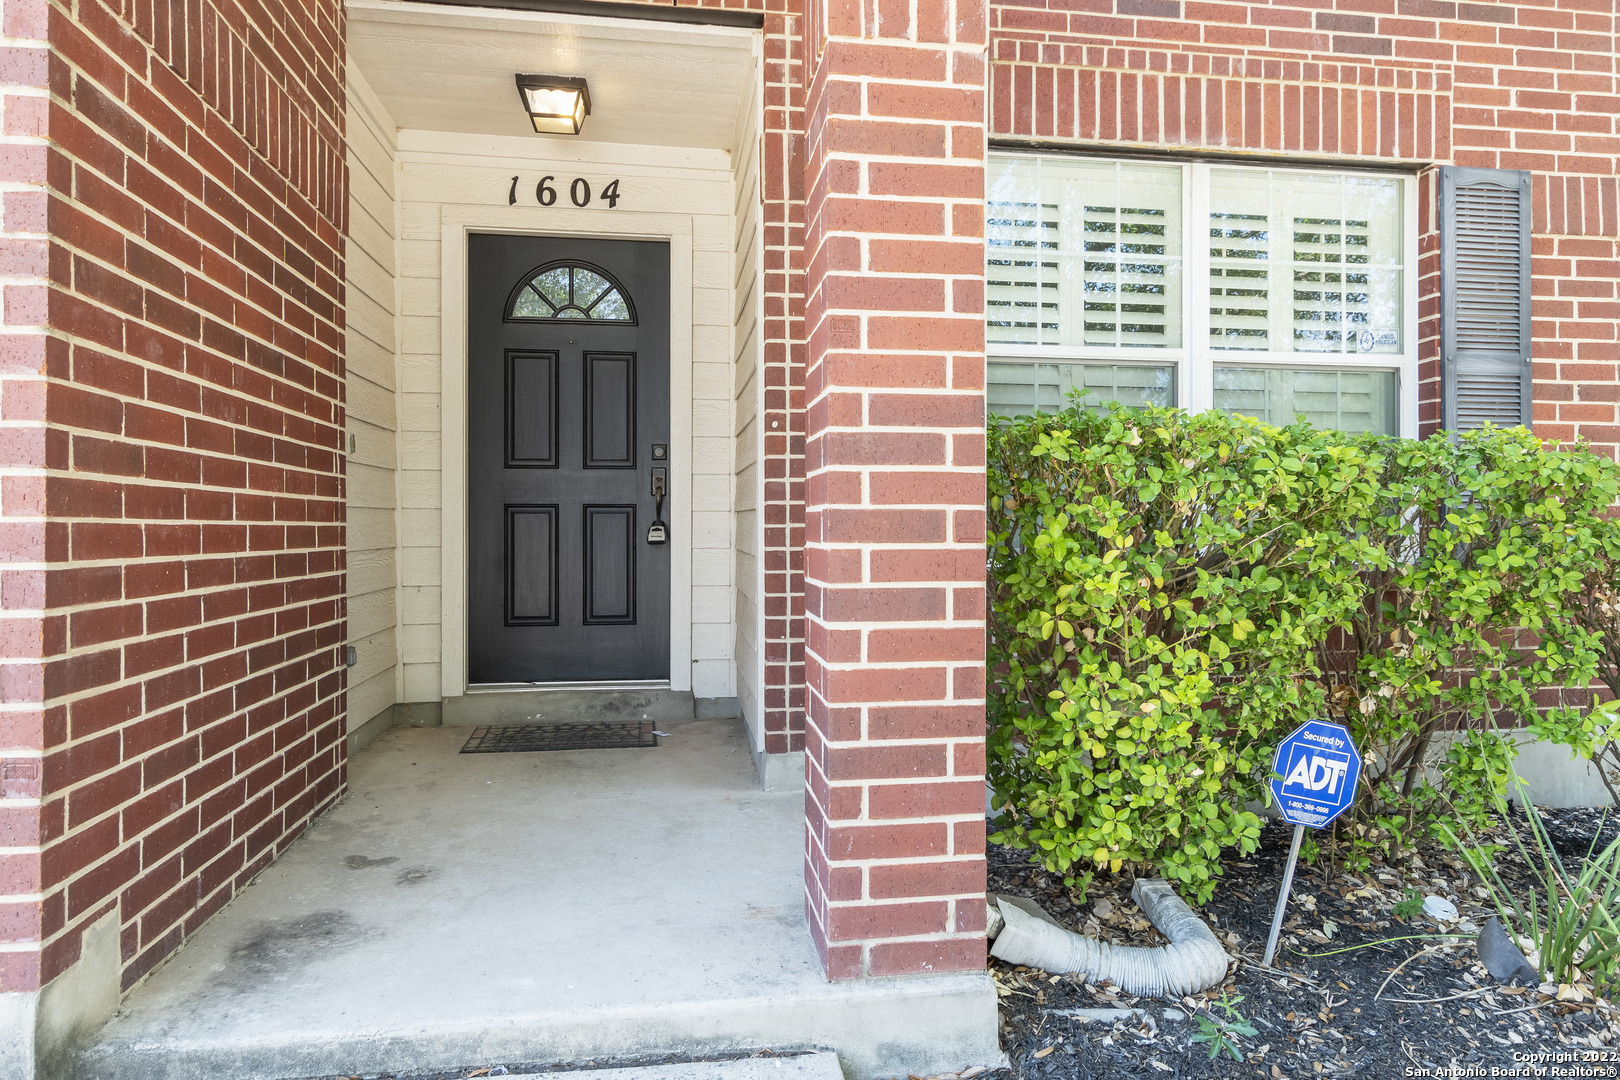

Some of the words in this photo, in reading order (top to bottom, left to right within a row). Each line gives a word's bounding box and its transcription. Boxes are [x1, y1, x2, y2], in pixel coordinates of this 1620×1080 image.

[509, 175, 620, 209] 1604
[1303, 730, 1334, 745] Secured
[1334, 737, 1345, 749] by
[1284, 754, 1347, 795] ADT
